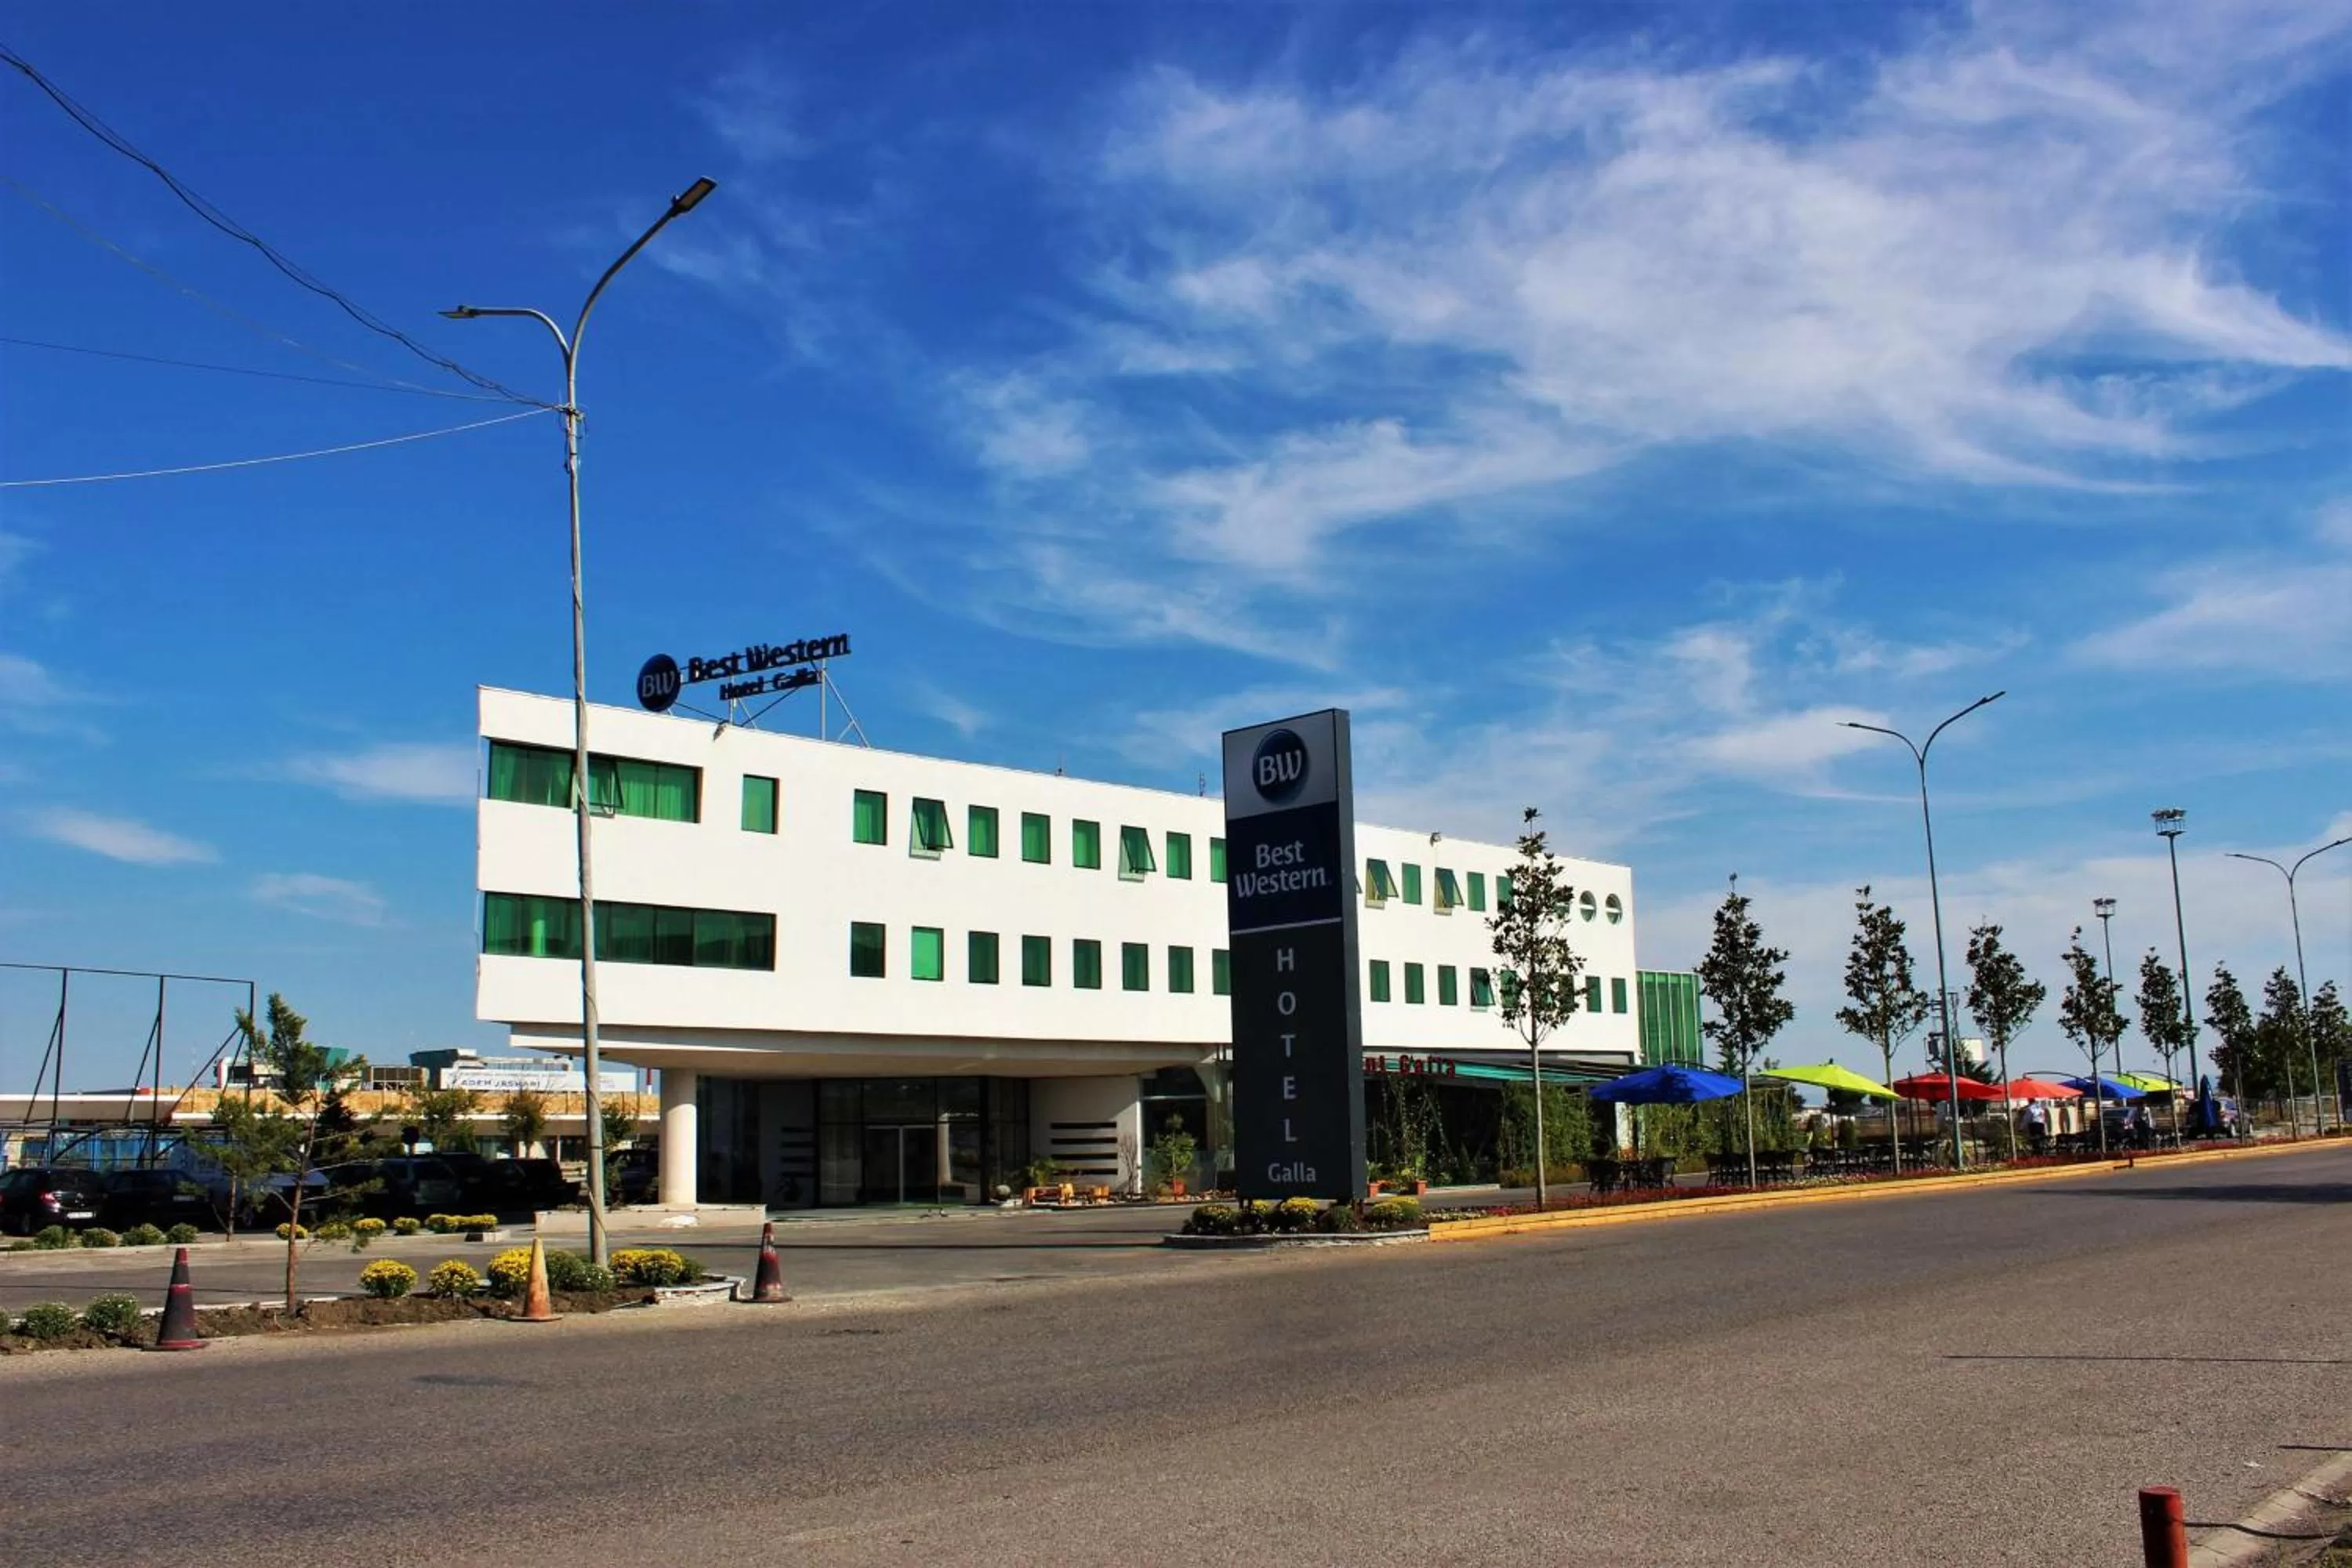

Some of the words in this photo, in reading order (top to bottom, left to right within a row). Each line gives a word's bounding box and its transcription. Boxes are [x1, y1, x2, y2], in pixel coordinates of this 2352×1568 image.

[688, 652, 742, 683] Best
[746, 633, 851, 672] Western
[641, 670, 675, 698] BW
[1259, 750, 1302, 787] BW
[1256, 840, 1305, 869] Best
[1235, 866, 1327, 898] Western
[1276, 947, 1298, 1142] HOTEL
[1268, 1162, 1317, 1183] Galla
